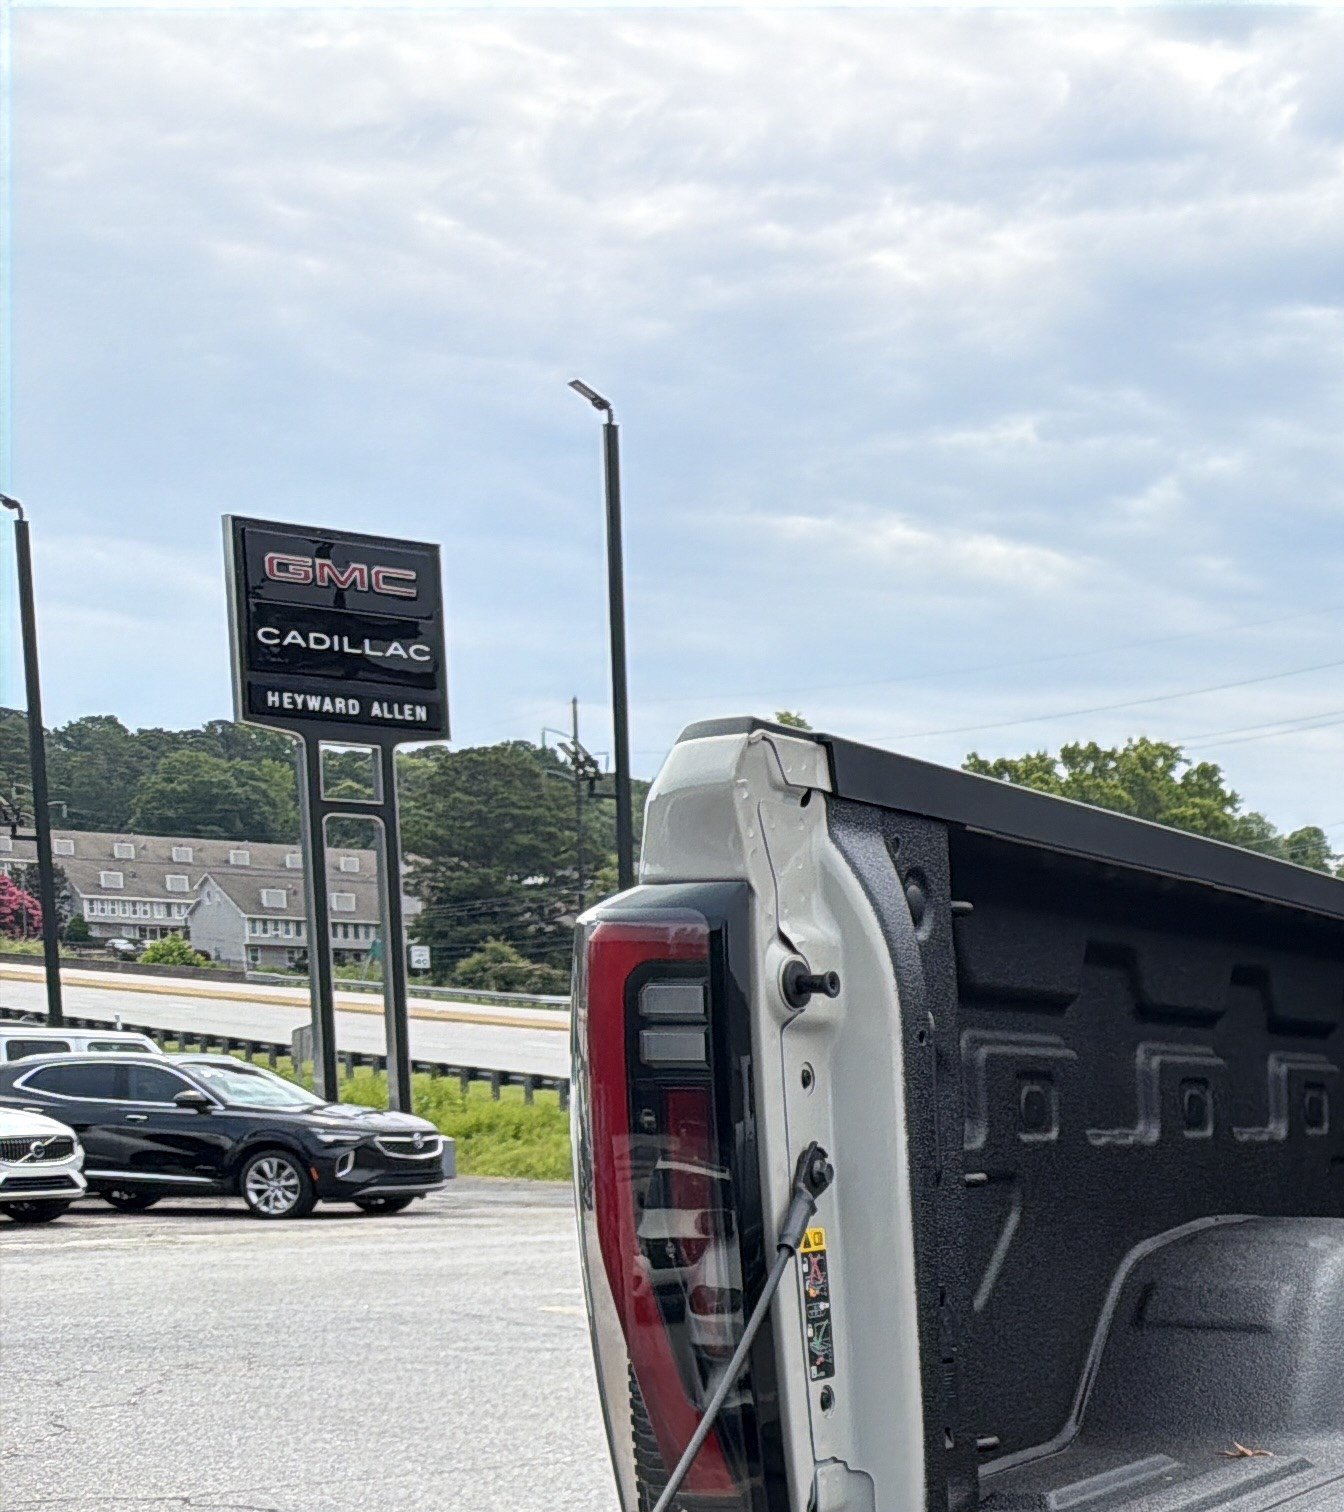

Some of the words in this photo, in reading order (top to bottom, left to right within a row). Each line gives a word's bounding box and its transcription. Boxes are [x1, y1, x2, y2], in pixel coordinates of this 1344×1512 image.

[264, 551, 418, 598] GMC
[256, 626, 431, 662] CADILLAC
[265, 690, 361, 715] HEYWARD
[371, 700, 428, 723] ALLEN
